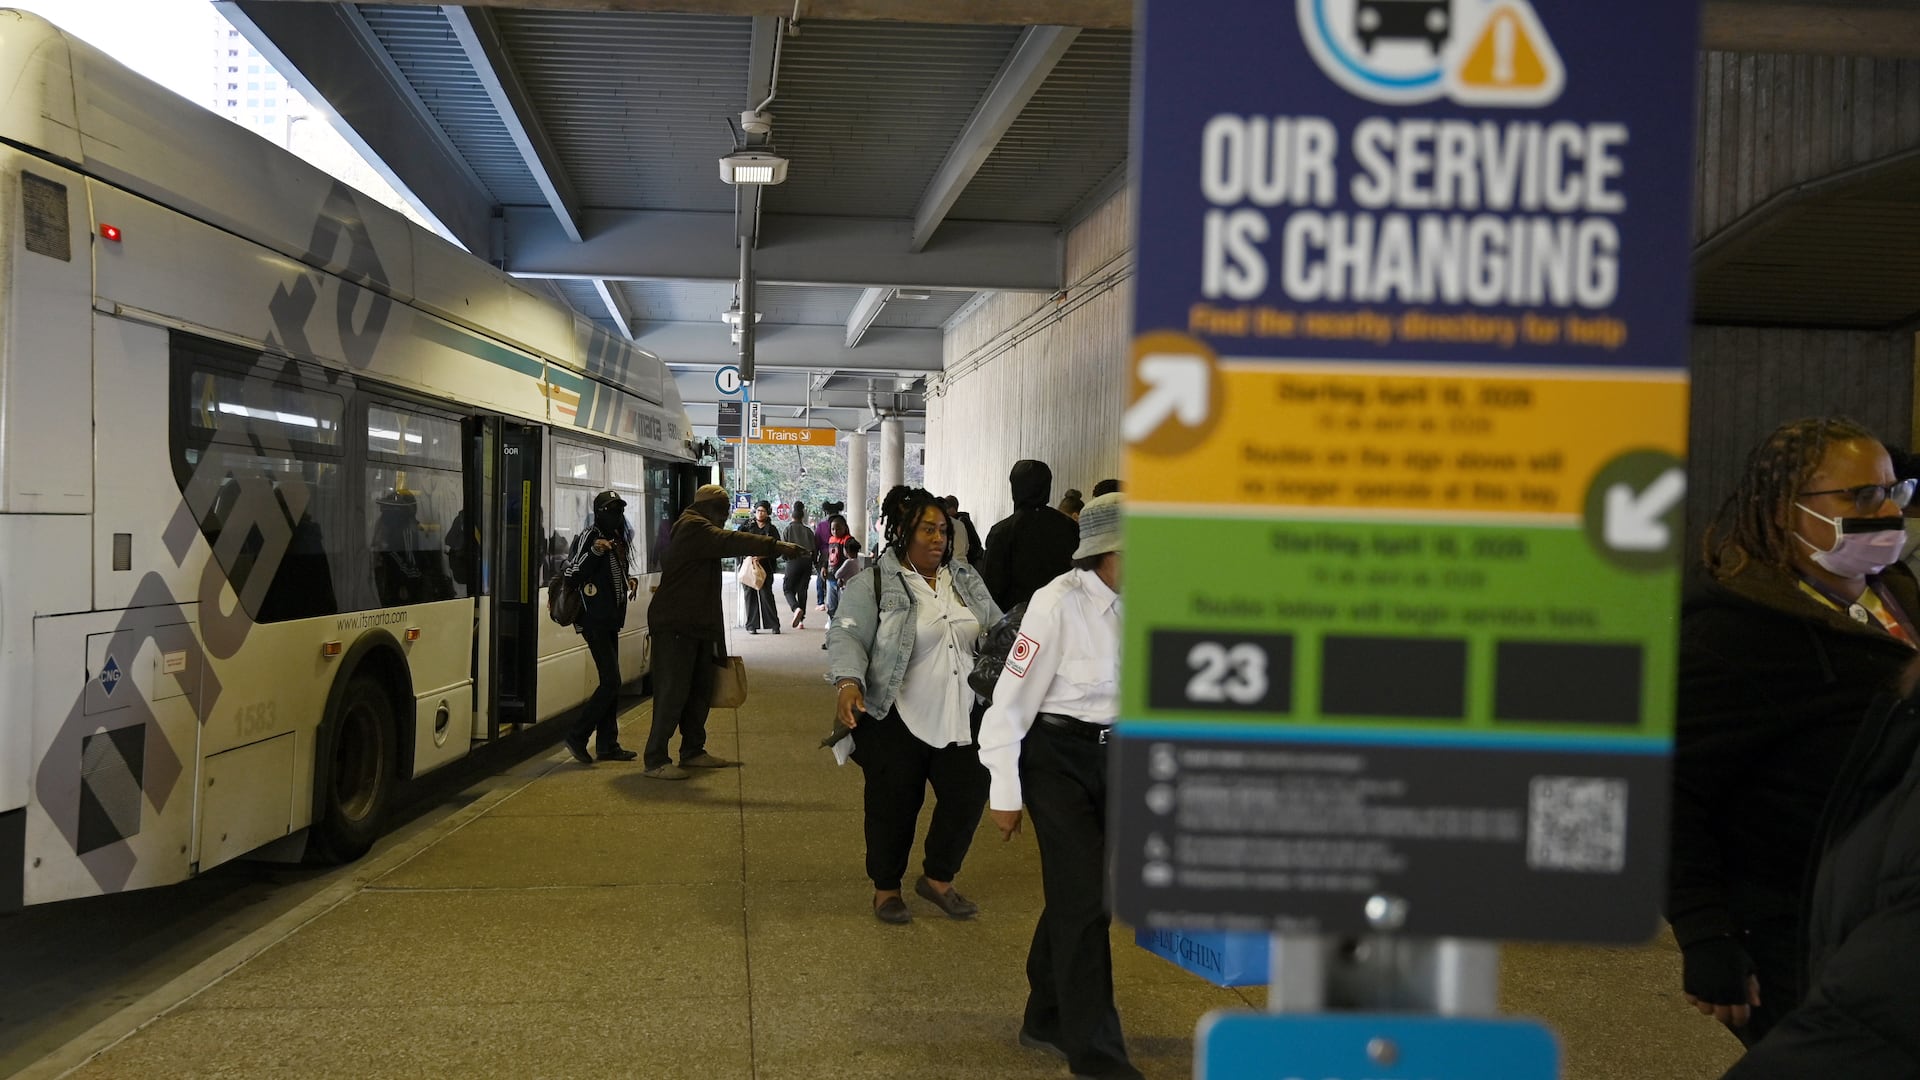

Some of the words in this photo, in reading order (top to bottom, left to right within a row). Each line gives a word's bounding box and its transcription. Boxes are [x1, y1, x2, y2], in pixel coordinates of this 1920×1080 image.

[1201, 114, 1337, 205] OUR
[1351, 117, 1628, 213] SERVICE
[1202, 208, 1269, 299] IS
[1281, 210, 1620, 308] CHANGING
[1189, 305, 1248, 333] Find
[1255, 307, 1294, 334] the
[1303, 309, 1392, 344] nearby
[1399, 312, 1514, 347] directory
[1522, 313, 1558, 342] for
[1278, 380, 1366, 407] Starting
[1377, 382, 1428, 409] April
[637, 412, 662, 441] marta
[766, 429, 798, 441] Trains
[503, 447, 519, 455] OOR
[1240, 442, 1314, 467] Routes
[1359, 444, 1389, 468] the
[1455, 447, 1516, 471] above
[1525, 449, 1564, 473] will
[1269, 531, 1360, 558] Starting
[1370, 533, 1422, 558] April
[336, 611, 408, 631] www.itsmarta.com
[1275, 595, 1337, 620] below
[1348, 597, 1382, 621] will
[1461, 602, 1538, 627] service
[101, 668, 120, 683] CNG
[1185, 643, 1269, 703] 23
[234, 701, 276, 738] 1583
